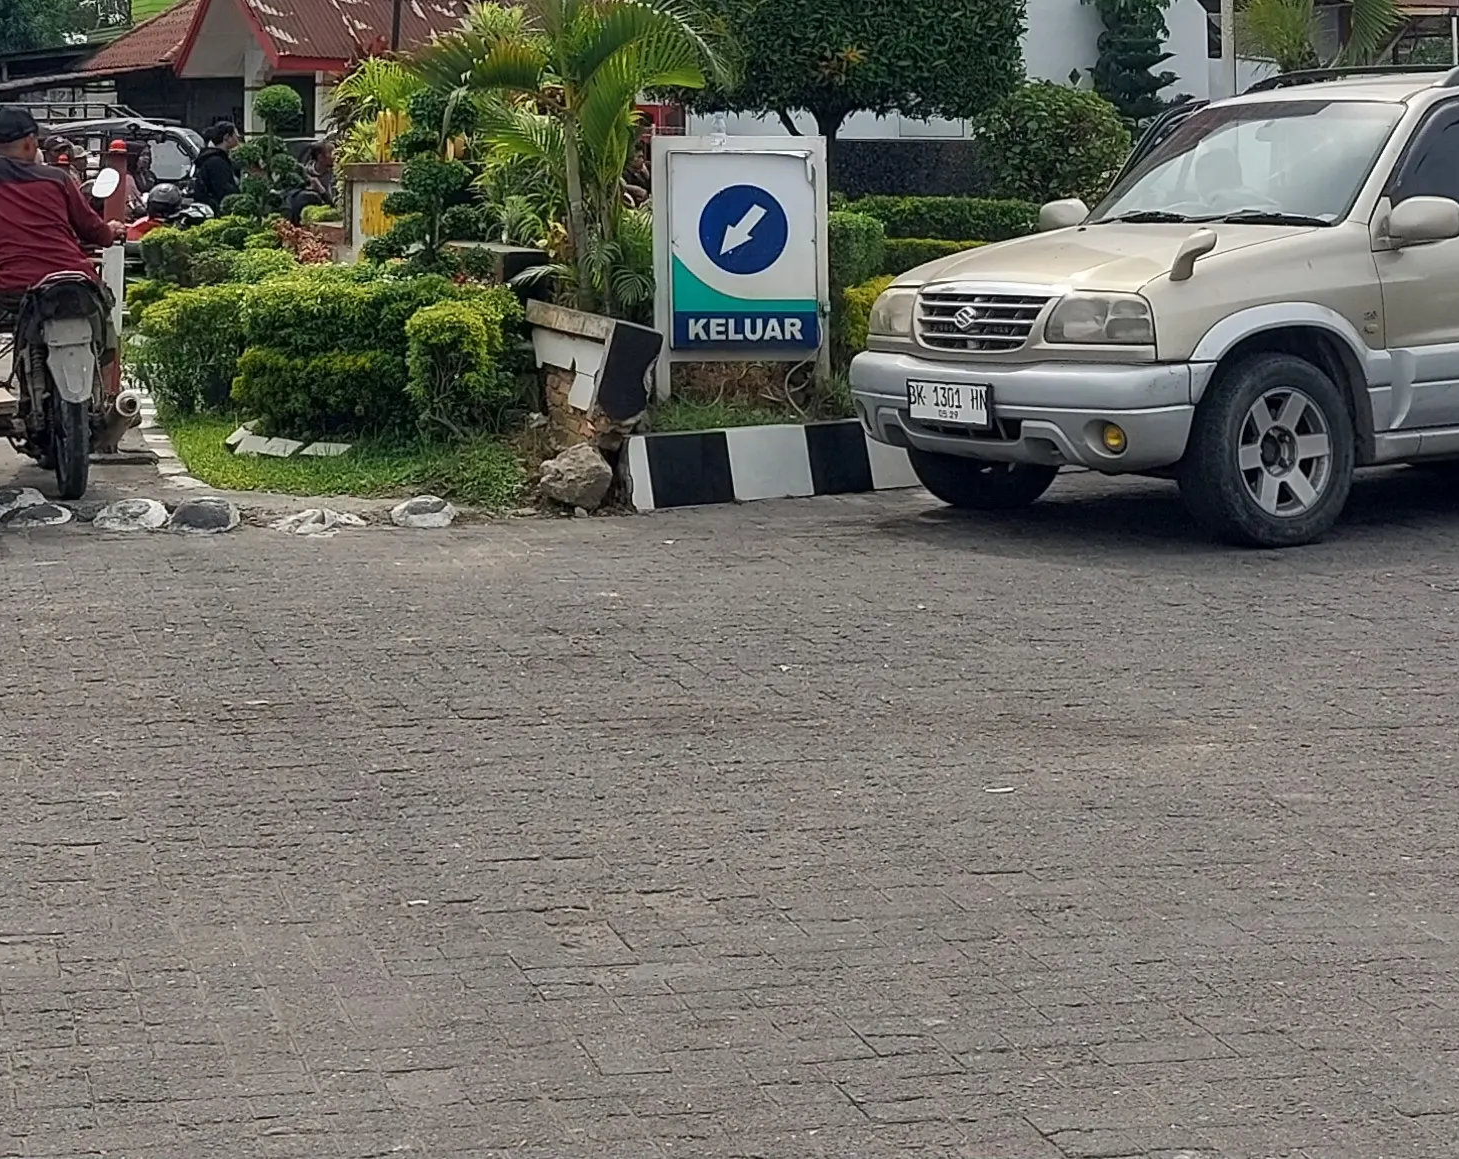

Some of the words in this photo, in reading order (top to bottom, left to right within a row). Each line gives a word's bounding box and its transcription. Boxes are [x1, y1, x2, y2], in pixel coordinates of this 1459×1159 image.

[688, 317, 804, 341] KELUAR
[908, 384, 926, 406] BK
[932, 385, 963, 409] 1301
[970, 388, 988, 411] HN
